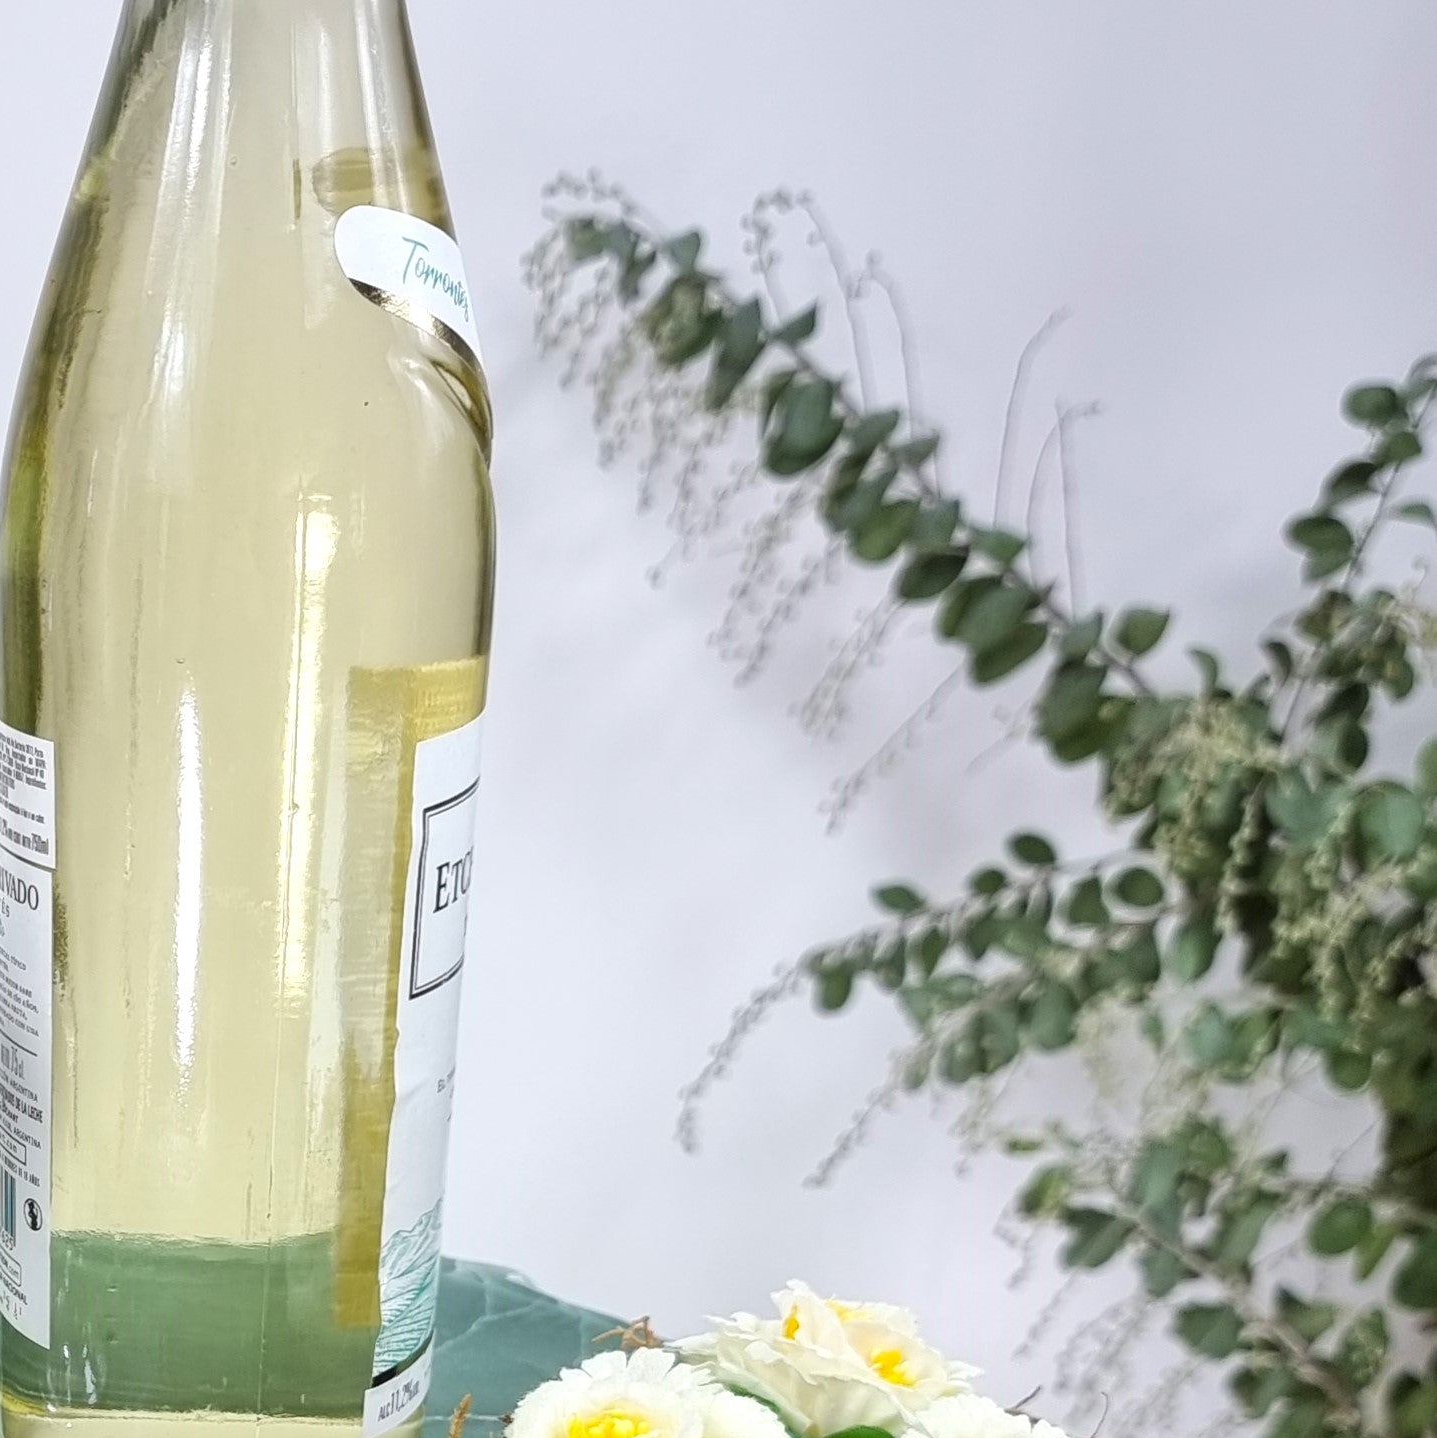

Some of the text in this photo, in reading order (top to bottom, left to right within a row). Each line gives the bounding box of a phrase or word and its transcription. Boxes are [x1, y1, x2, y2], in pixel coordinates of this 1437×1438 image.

[9, 1079, 38, 1102] ARGENTINA
[27, 1104, 43, 1123] LECHE
[13, 1127, 42, 1150] ARGENTINA
